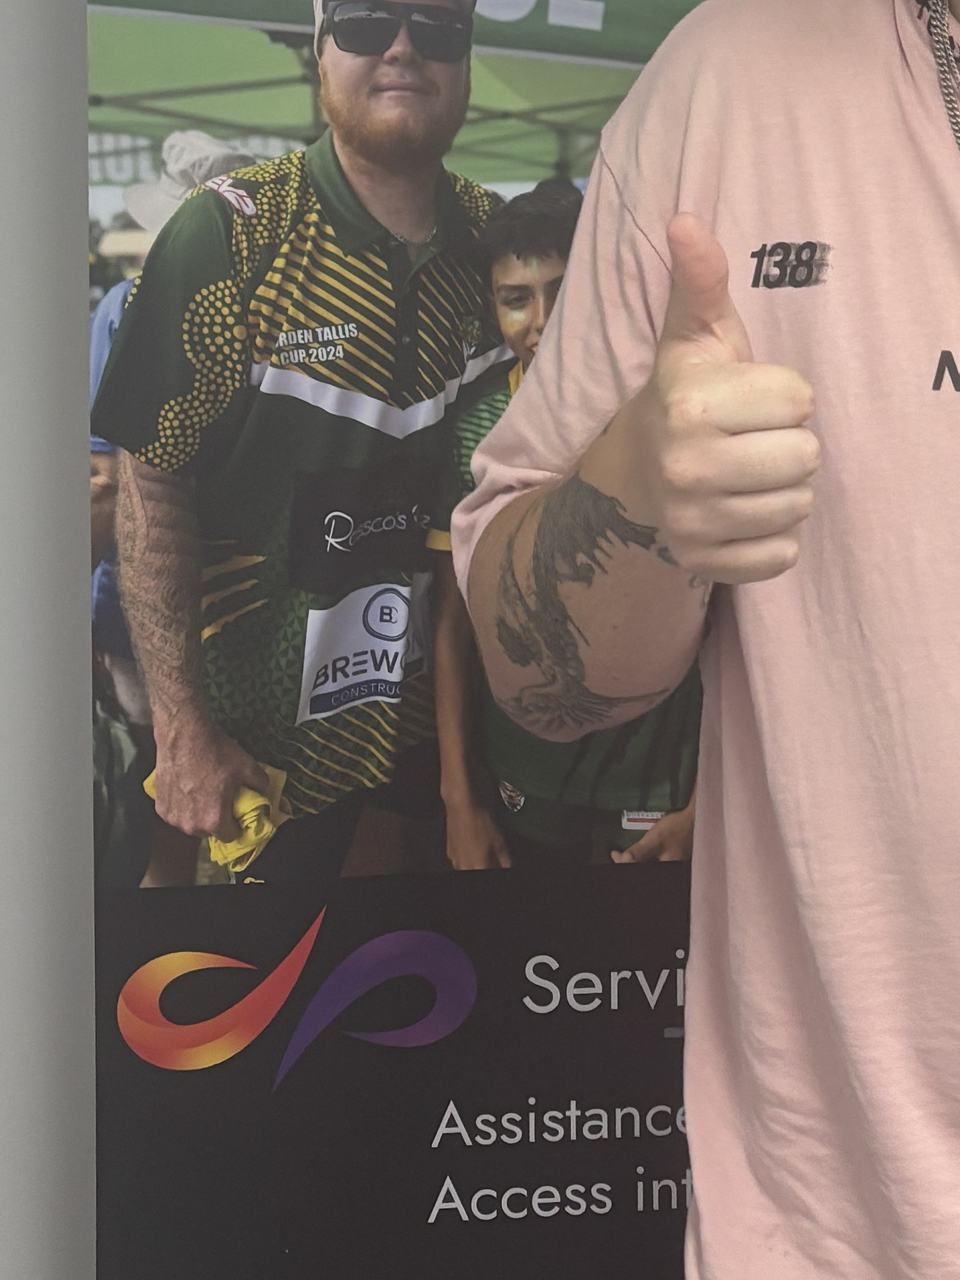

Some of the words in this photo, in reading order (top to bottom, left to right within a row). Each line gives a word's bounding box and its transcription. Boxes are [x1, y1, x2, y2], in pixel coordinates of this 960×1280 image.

[749, 240, 833, 289] 138
[275, 328, 313, 348] RDEN
[315, 322, 359, 342] TALLIS
[279, 349, 306, 366] CUP
[309, 345, 345, 363] 2024
[312, 649, 405, 692] BREW
[522, 948, 686, 1014] Servi
[427, 1175, 613, 1224] Access
[636, 1166, 694, 1212] int
